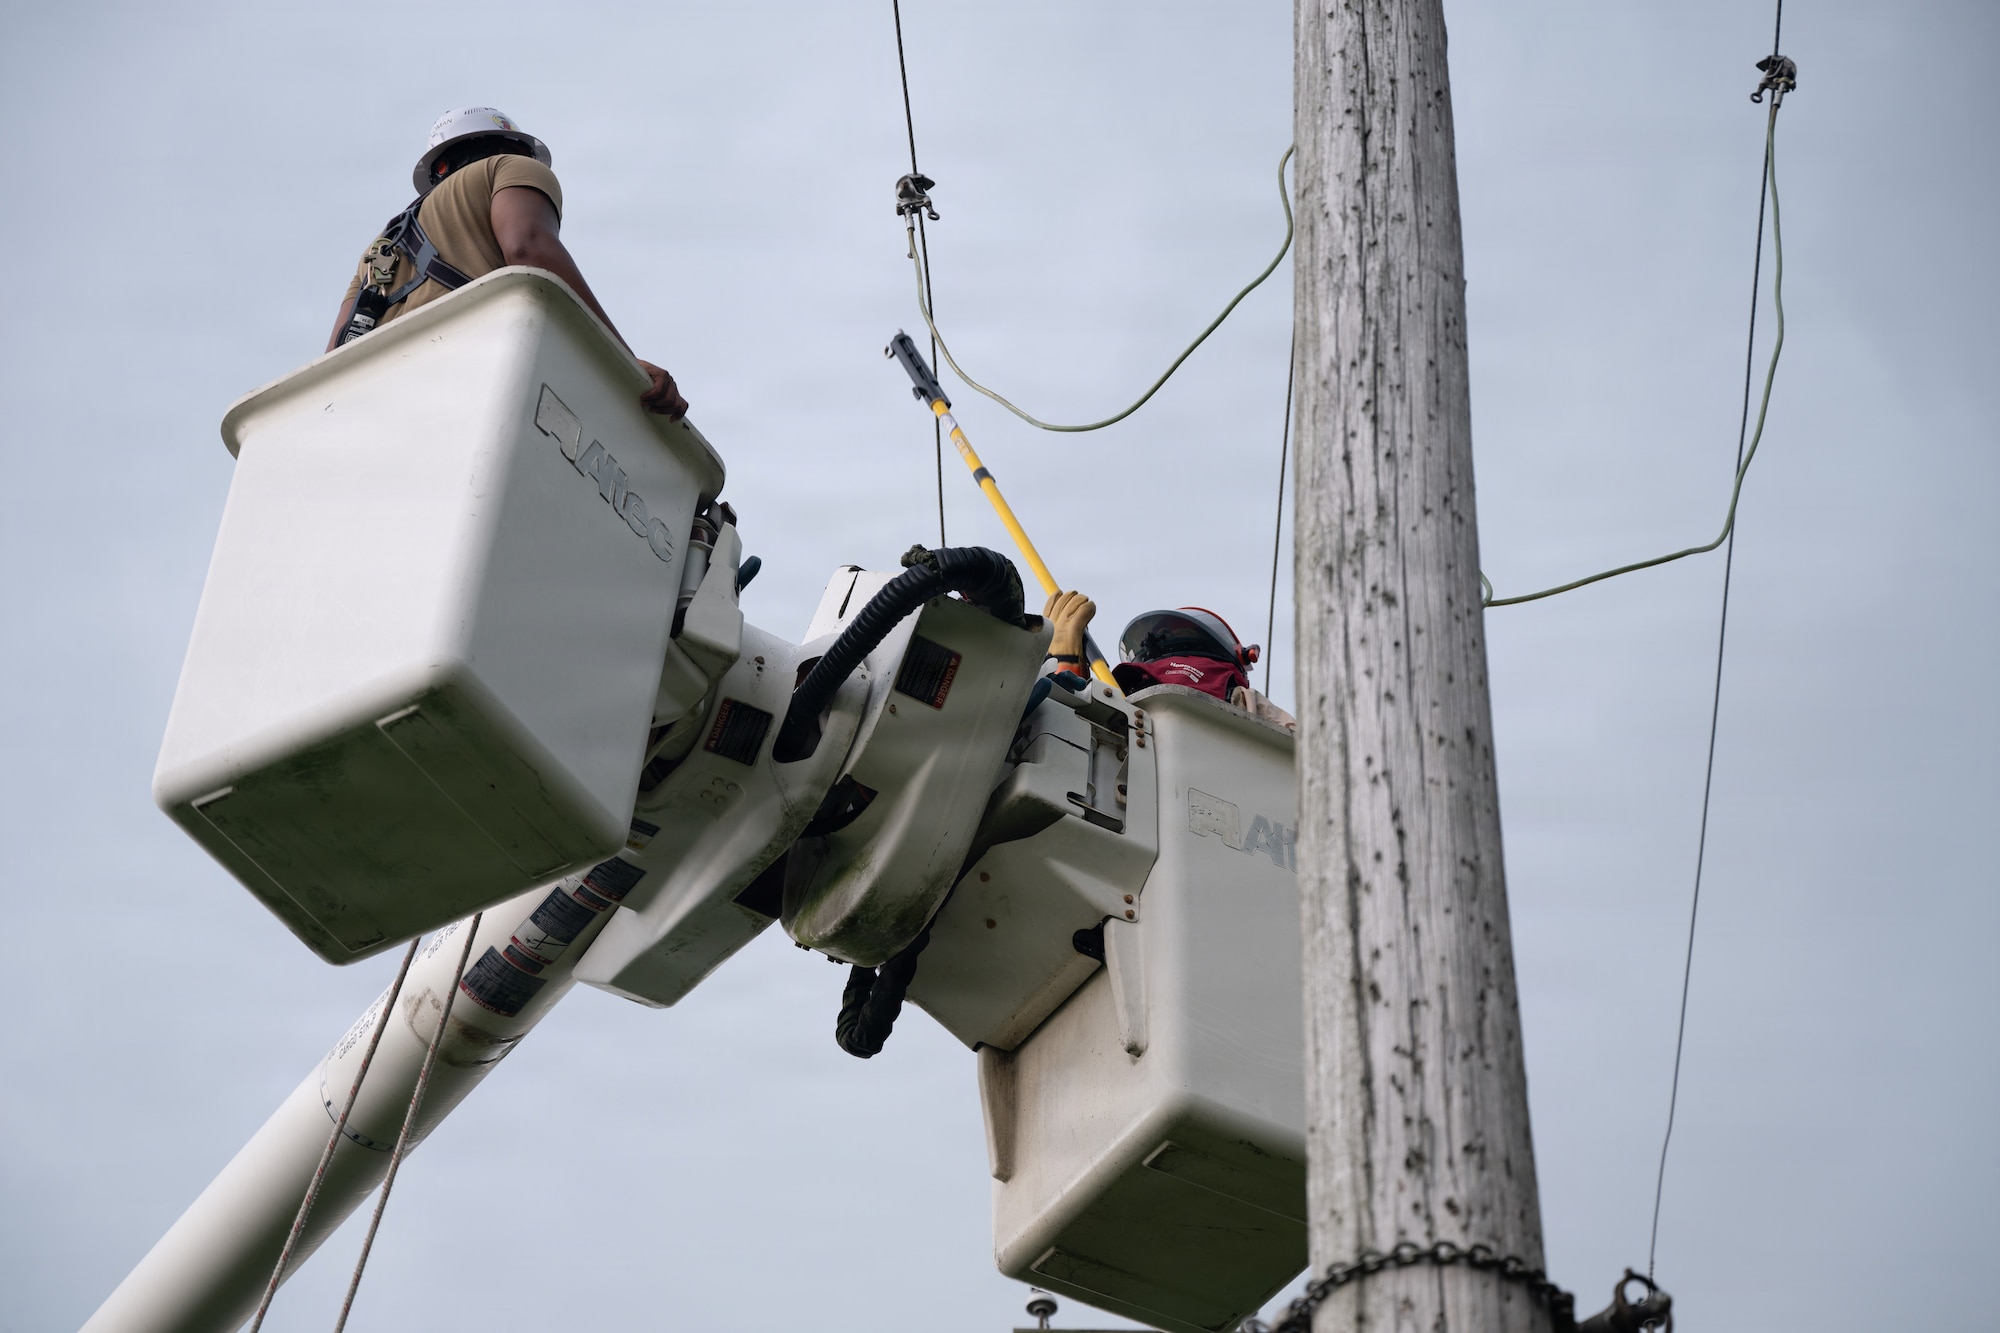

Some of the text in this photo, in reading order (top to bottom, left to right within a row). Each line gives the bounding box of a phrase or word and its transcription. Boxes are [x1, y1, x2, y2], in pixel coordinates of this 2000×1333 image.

[935, 668, 955, 704] DANGER
[711, 703, 731, 738] DANGER
[1241, 814, 1297, 873] Alt
[464, 987, 498, 1013] DANGER
